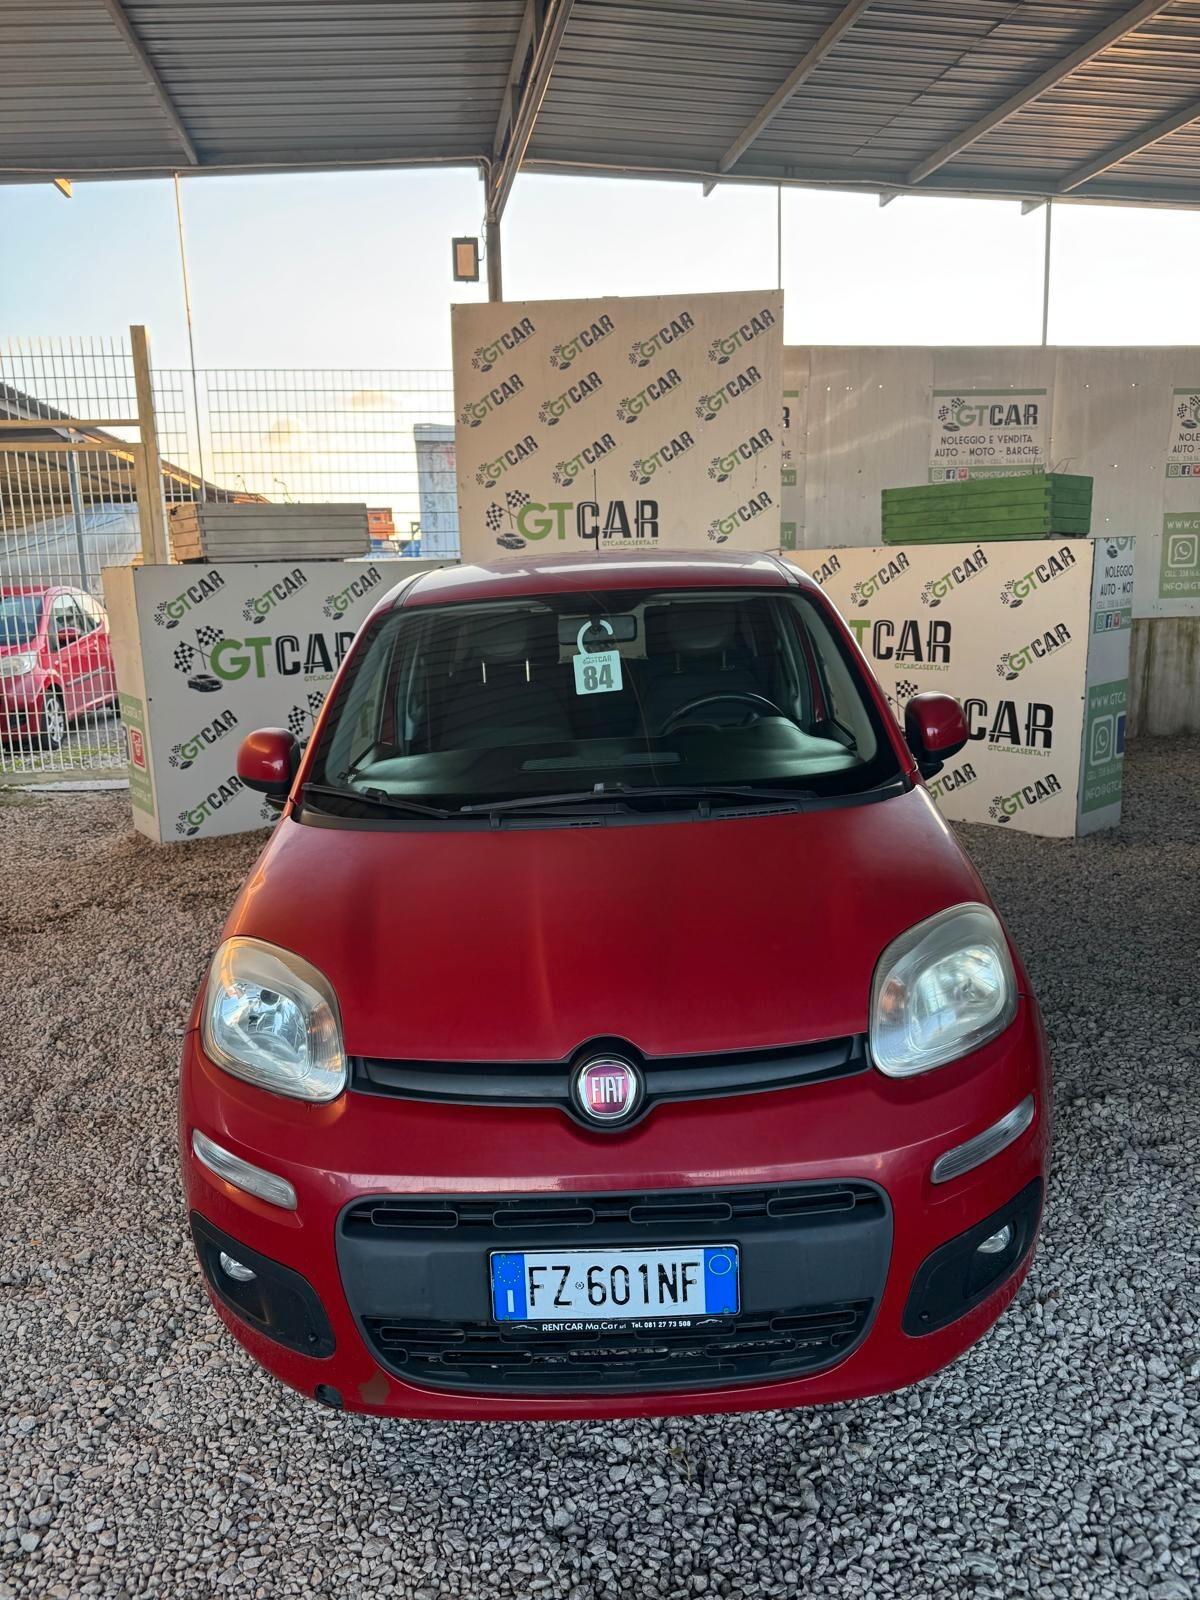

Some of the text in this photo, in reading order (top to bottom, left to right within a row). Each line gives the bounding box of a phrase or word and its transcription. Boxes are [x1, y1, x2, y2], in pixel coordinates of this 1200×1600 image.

[483, 317, 535, 363] GTCAR
[560, 314, 615, 362] GTCAR
[640, 311, 695, 359] GTCAR
[720, 308, 775, 357] GTCAR
[472, 373, 525, 418] GTCAR
[549, 371, 603, 417] GTCAR
[628, 368, 682, 415] GTCAR
[707, 366, 762, 413] GTCAR
[956, 404, 1038, 427] GTCAR
[486, 435, 539, 479] GTCAR
[563, 433, 617, 479] GTCAR
[641, 431, 695, 478] GTCAR
[719, 428, 774, 475] GTCAR
[934, 448, 958, 457] AUTO
[969, 447, 995, 456] MOTO
[1006, 446, 1040, 455] BARCHE
[941, 434, 1033, 445] NOLEGGIO E VENDITA
[1172, 445, 1195, 453] AUTO
[516, 500, 659, 541] GTCAR
[718, 491, 773, 537] GTCAR
[1167, 521, 1200, 529] WWW.G
[167, 570, 225, 620] GTCAR
[254, 568, 308, 615] GTCAR
[334, 567, 381, 611] GTCAR
[860, 551, 910, 599] GTCAR
[931, 548, 989, 599] GTCAR
[1012, 546, 1077, 601] GTCAR
[895, 662, 950, 672] GTCARCASERTA.IT
[1009, 623, 1071, 672] GTCAR
[583, 664, 614, 690] 84
[181, 709, 239, 760] GTCAR
[955, 697, 1053, 749] CAR
[988, 745, 1051, 757] GTCARCASERTA.IT
[188, 775, 244, 825] GTCAR
[1003, 773, 1062, 816] GTCAR
[591, 1076, 625, 1103] FIAT
